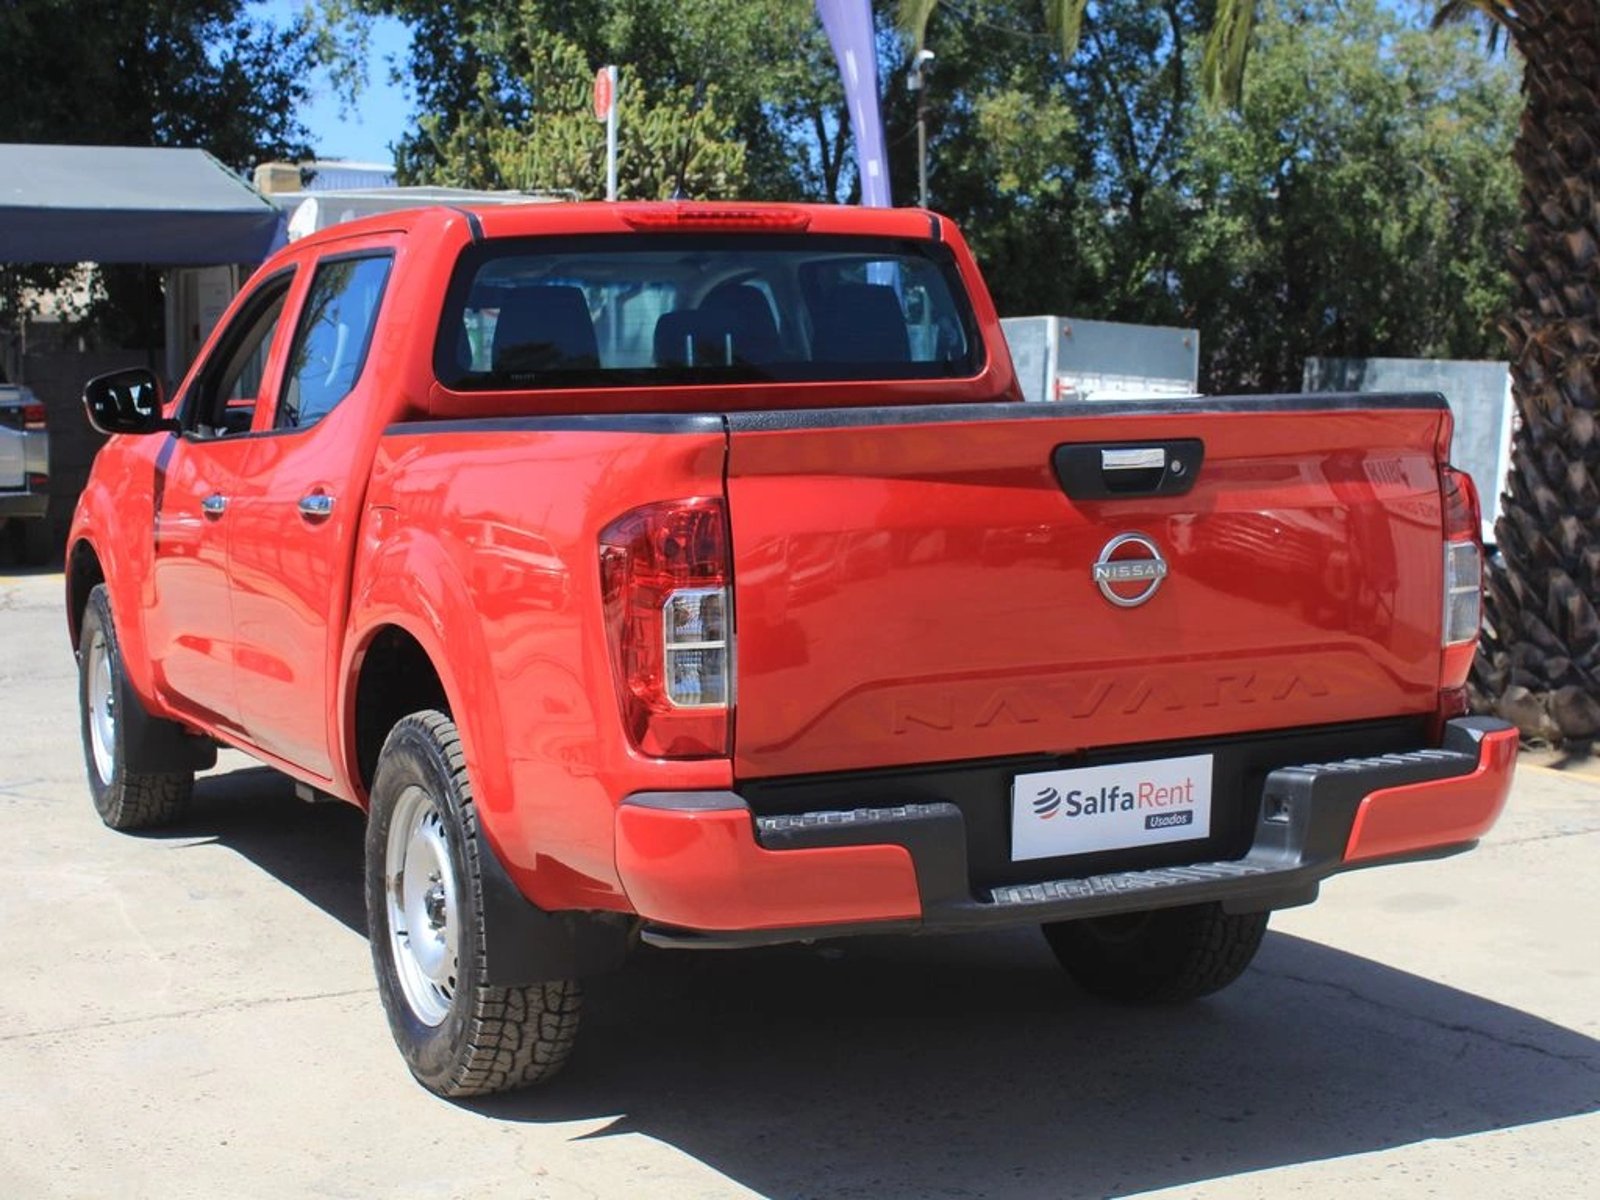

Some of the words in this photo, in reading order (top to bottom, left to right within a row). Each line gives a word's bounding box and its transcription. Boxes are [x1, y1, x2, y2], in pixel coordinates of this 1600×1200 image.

[1096, 564, 1165, 578] NISSAN
[893, 672, 1329, 734] NAVARA
[1150, 812, 1188, 828] Usados
